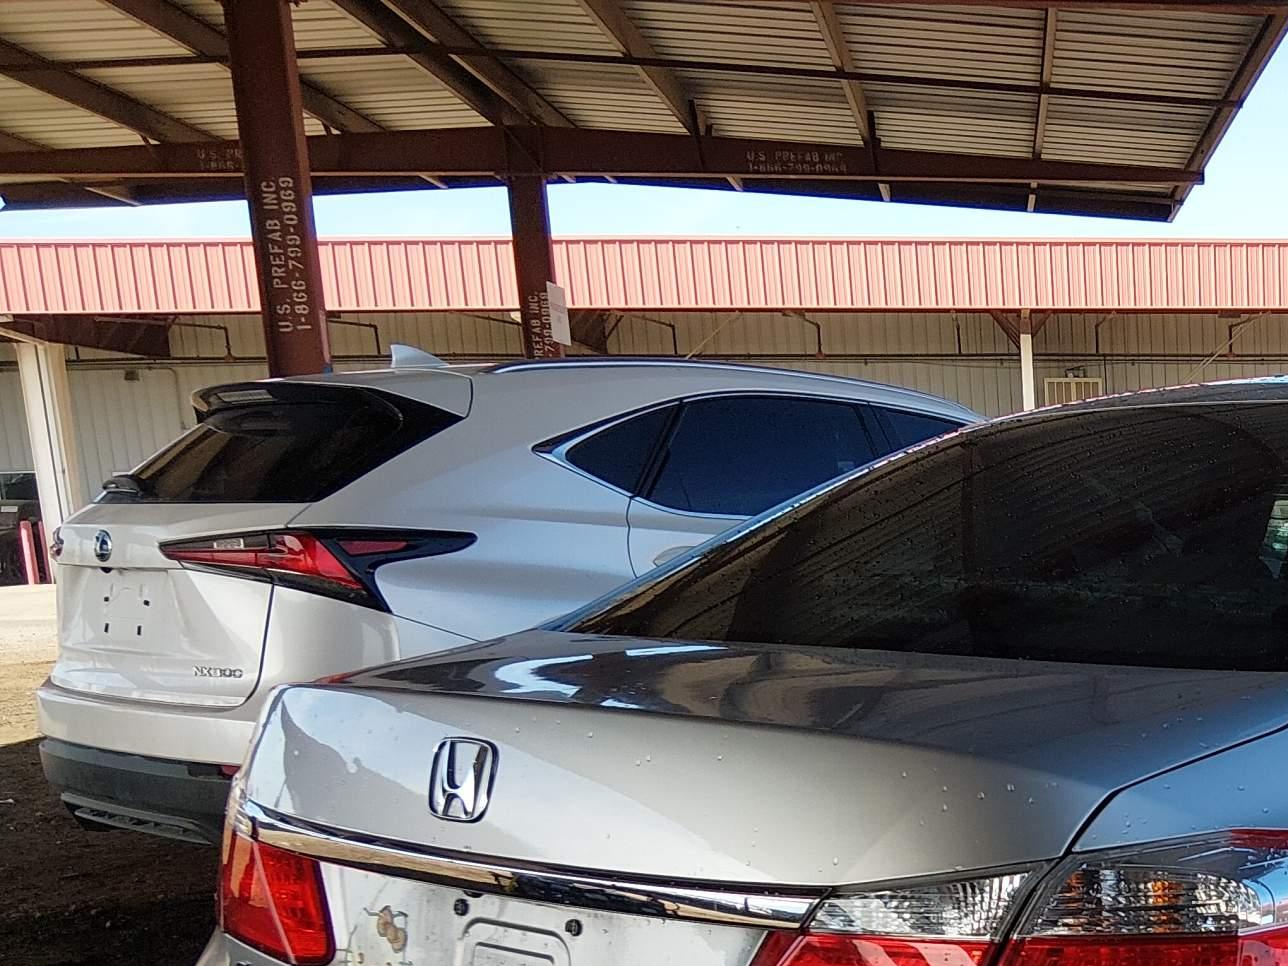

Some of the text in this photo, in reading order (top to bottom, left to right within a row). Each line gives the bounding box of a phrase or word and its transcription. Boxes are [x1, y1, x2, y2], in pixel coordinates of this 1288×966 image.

[265, 218, 289, 289] PREFAB
[278, 176, 312, 330] 1-866-799-0969
[530, 319, 544, 359] REFAB
